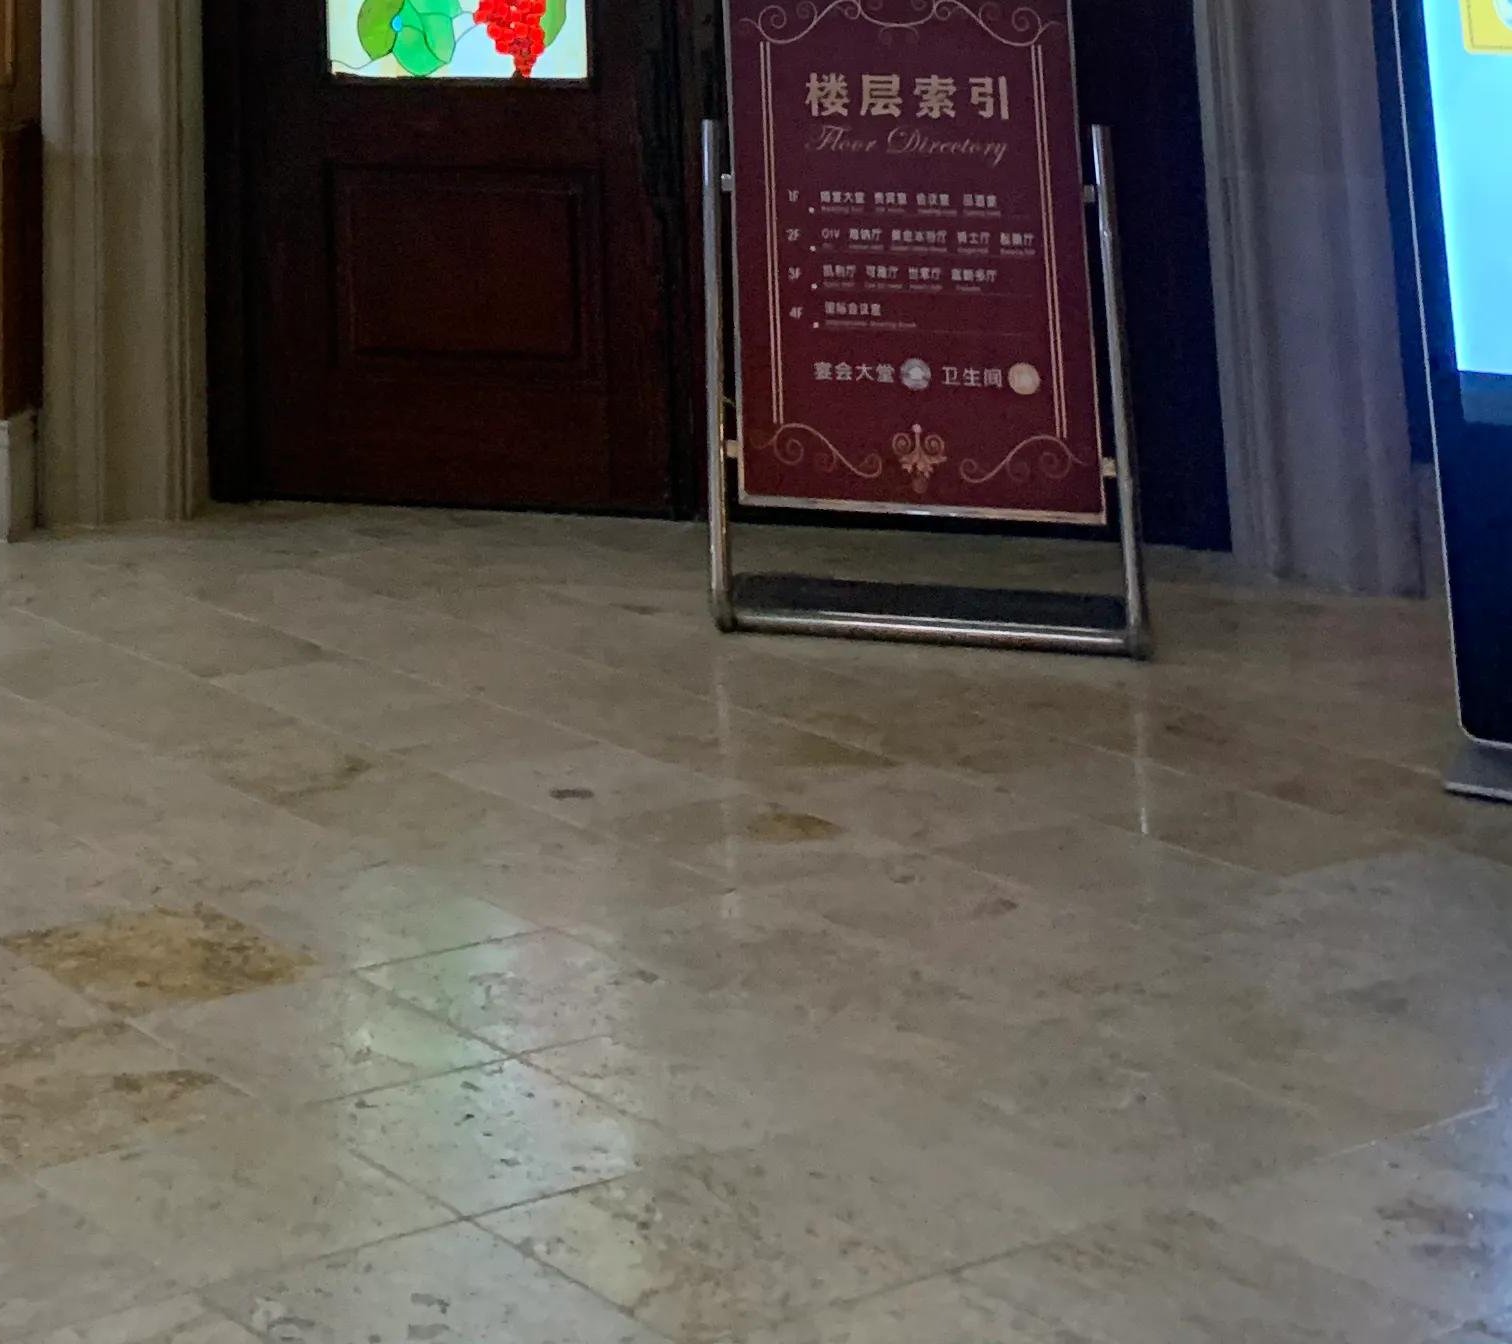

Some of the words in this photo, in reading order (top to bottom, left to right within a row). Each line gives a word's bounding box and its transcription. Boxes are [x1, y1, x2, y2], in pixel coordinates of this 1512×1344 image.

[805, 72, 1009, 120] 楼层索引
[804, 124, 878, 153] Floor
[886, 125, 1008, 167] Directory
[813, 362, 895, 383] 宴会大堂
[942, 366, 1003, 388] 卫生间
